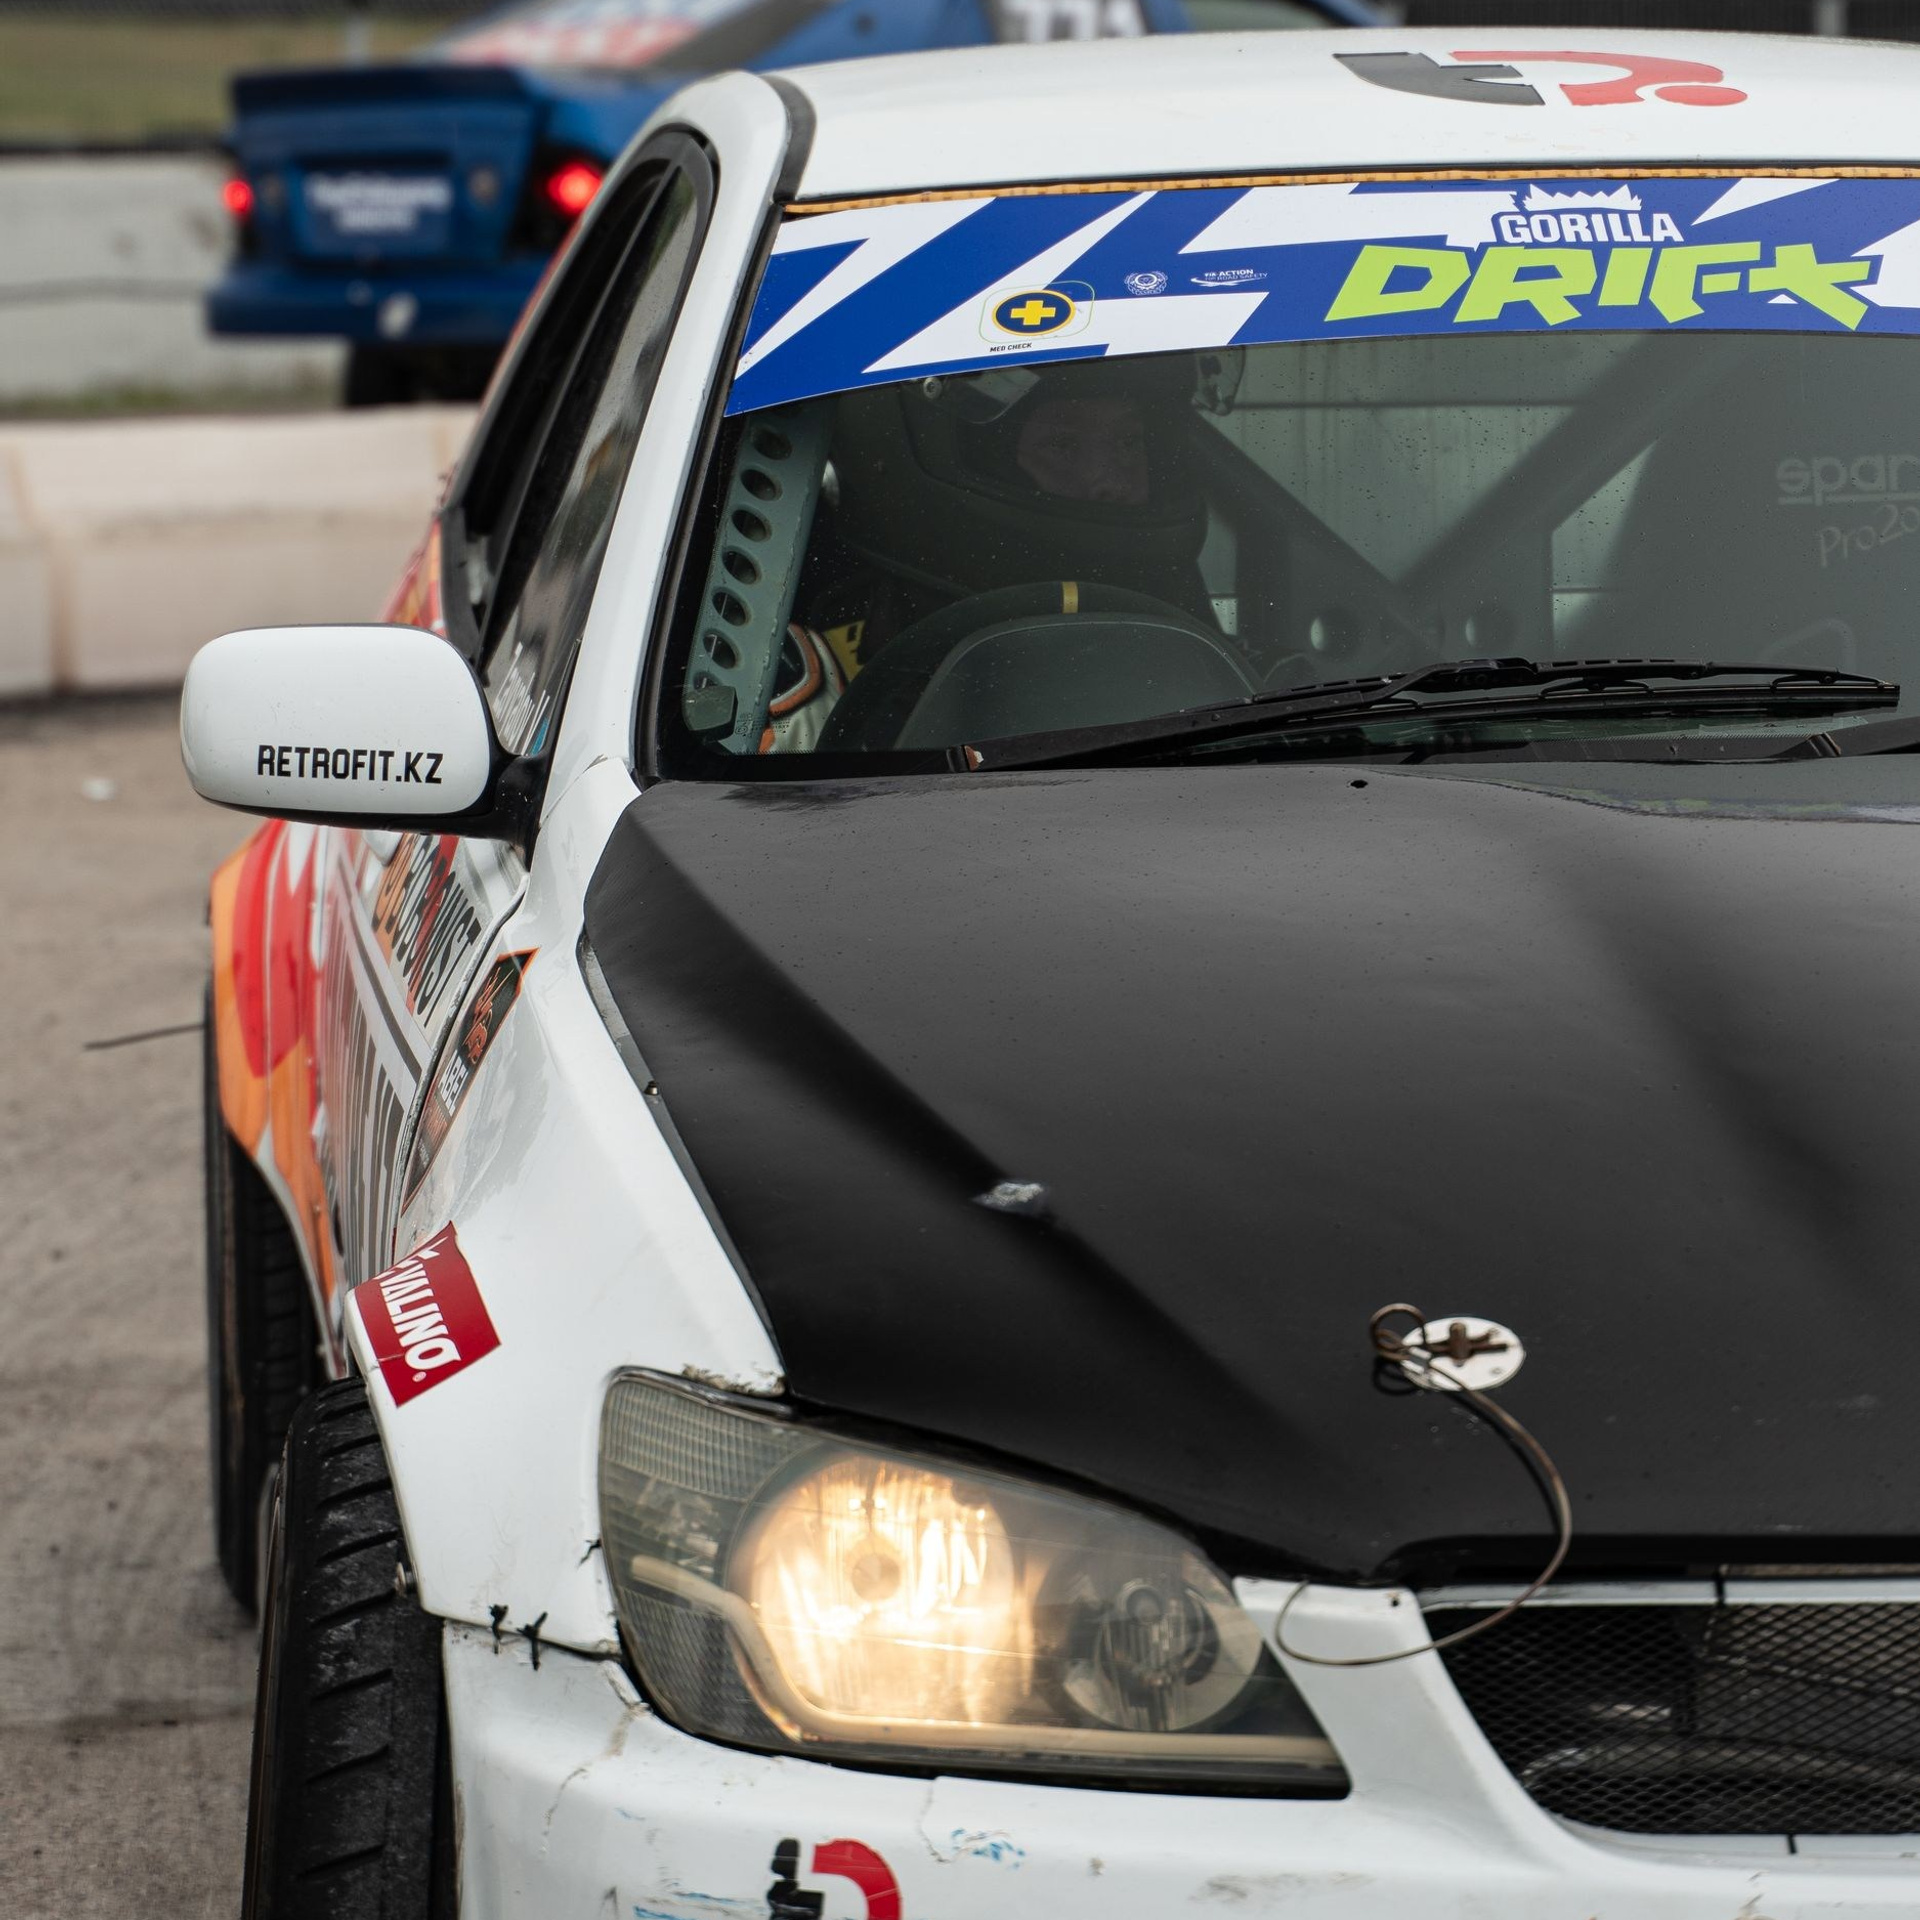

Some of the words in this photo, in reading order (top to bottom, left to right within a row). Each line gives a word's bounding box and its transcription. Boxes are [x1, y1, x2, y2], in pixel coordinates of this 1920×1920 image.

[1499, 213, 1684, 243] GORILLA
[1219, 269, 1254, 277] ACTION
[1324, 241, 1871, 331] DRIFT
[1007, 342, 1032, 351] CHECK
[257, 744, 444, 784] RETROFIT.KZ
[379, 1262, 462, 1371] VALINO
